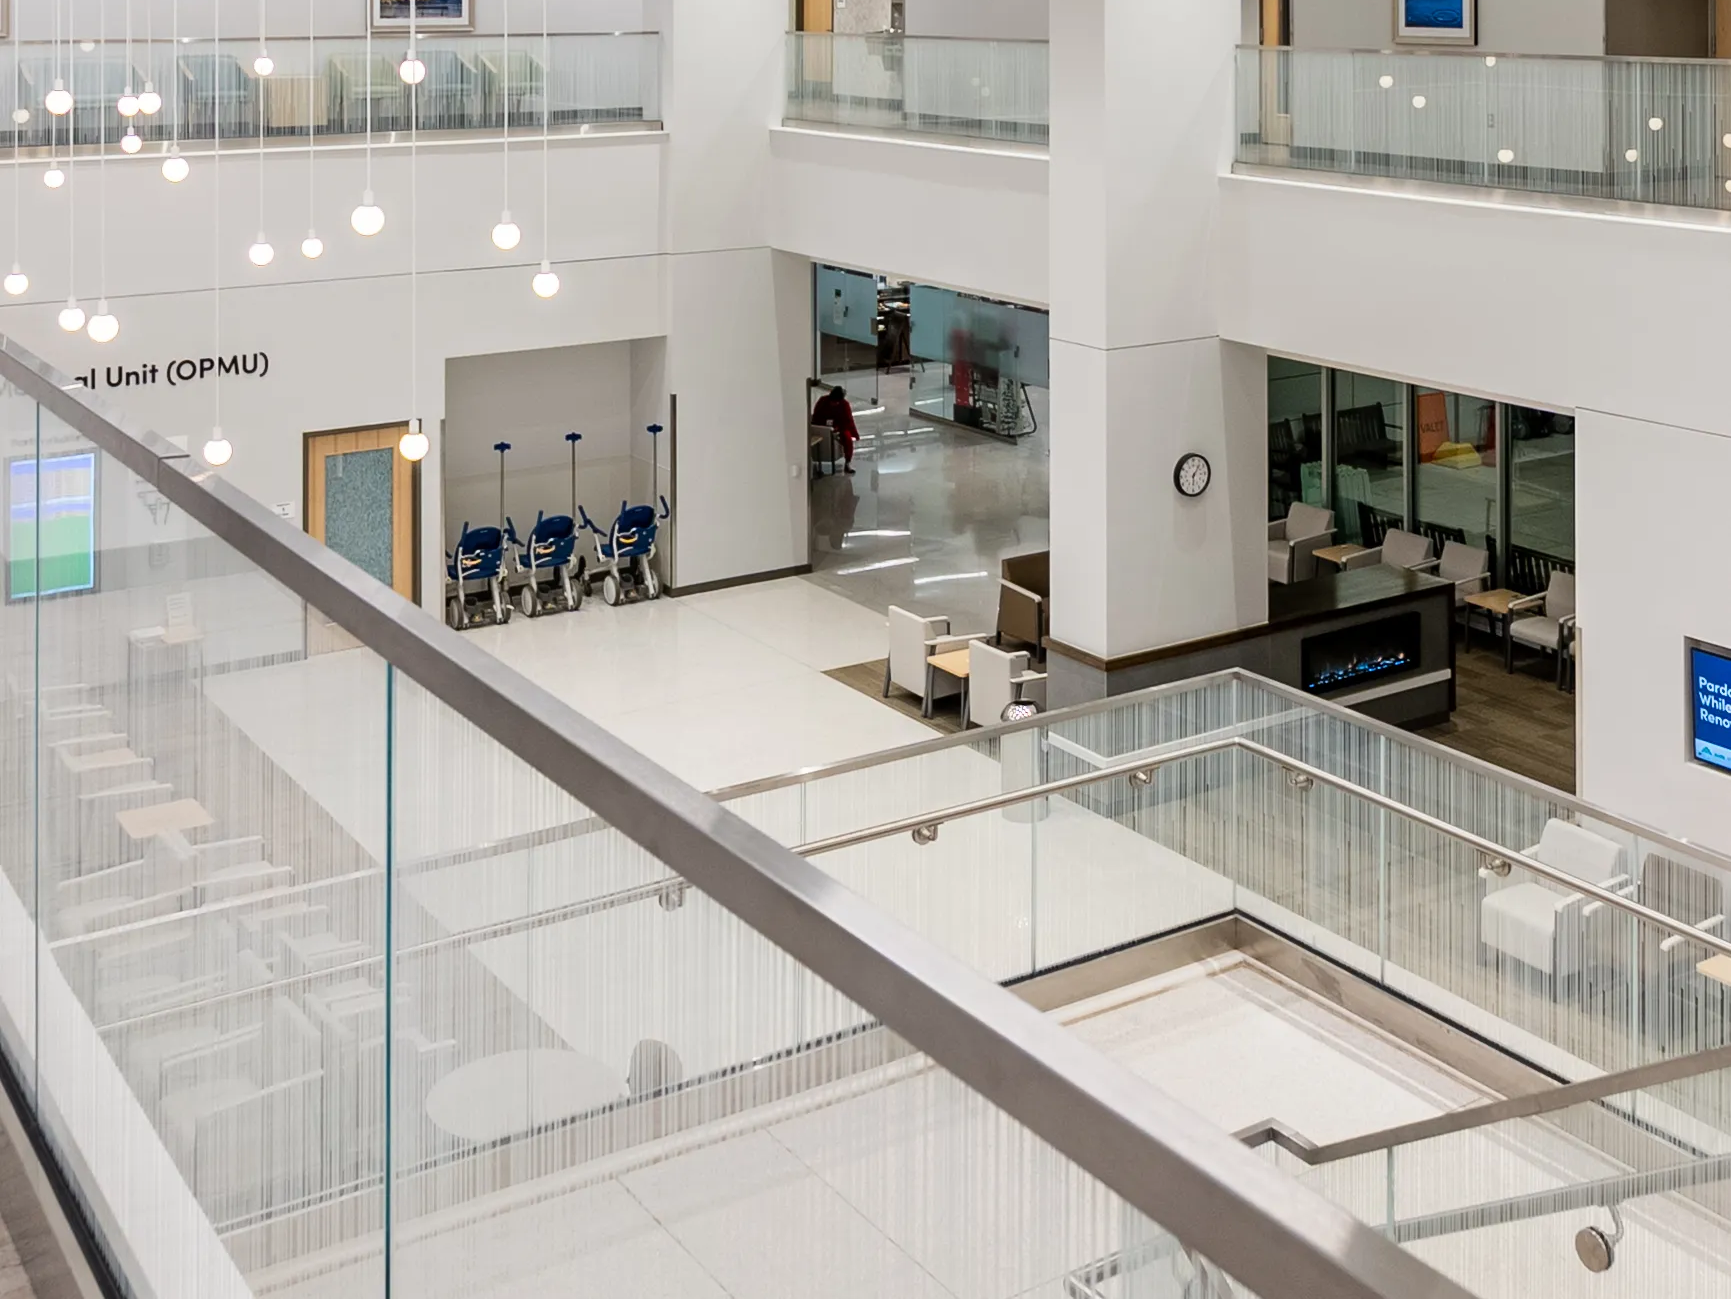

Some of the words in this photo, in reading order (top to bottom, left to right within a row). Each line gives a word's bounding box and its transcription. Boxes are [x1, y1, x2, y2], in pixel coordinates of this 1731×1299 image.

[106, 364, 158, 388] Unit
[166, 351, 269, 387] (OPMU)
[1699, 691, 1731, 713] While
[1700, 707, 1731, 729] Reno
